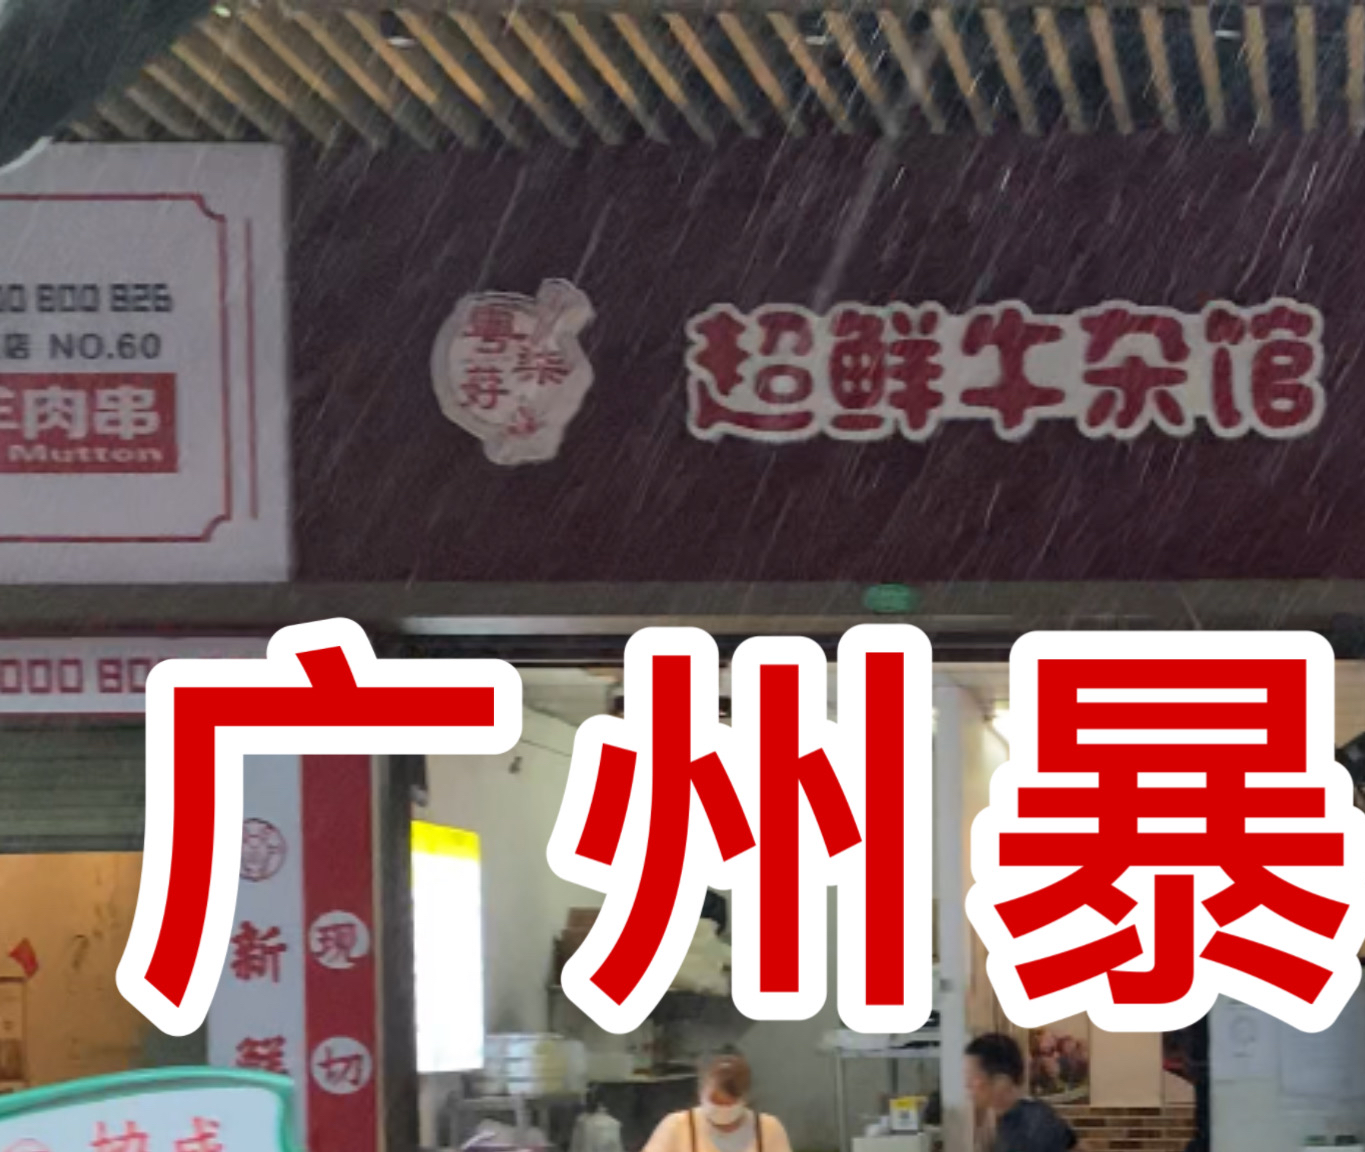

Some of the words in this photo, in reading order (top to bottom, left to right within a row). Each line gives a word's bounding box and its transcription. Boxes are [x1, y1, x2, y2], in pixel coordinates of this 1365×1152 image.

[50, 332, 162, 360] NO.60
[687, 300, 1324, 440] 超鲜牛杂馆
[8, 443, 164, 464] Mutton
